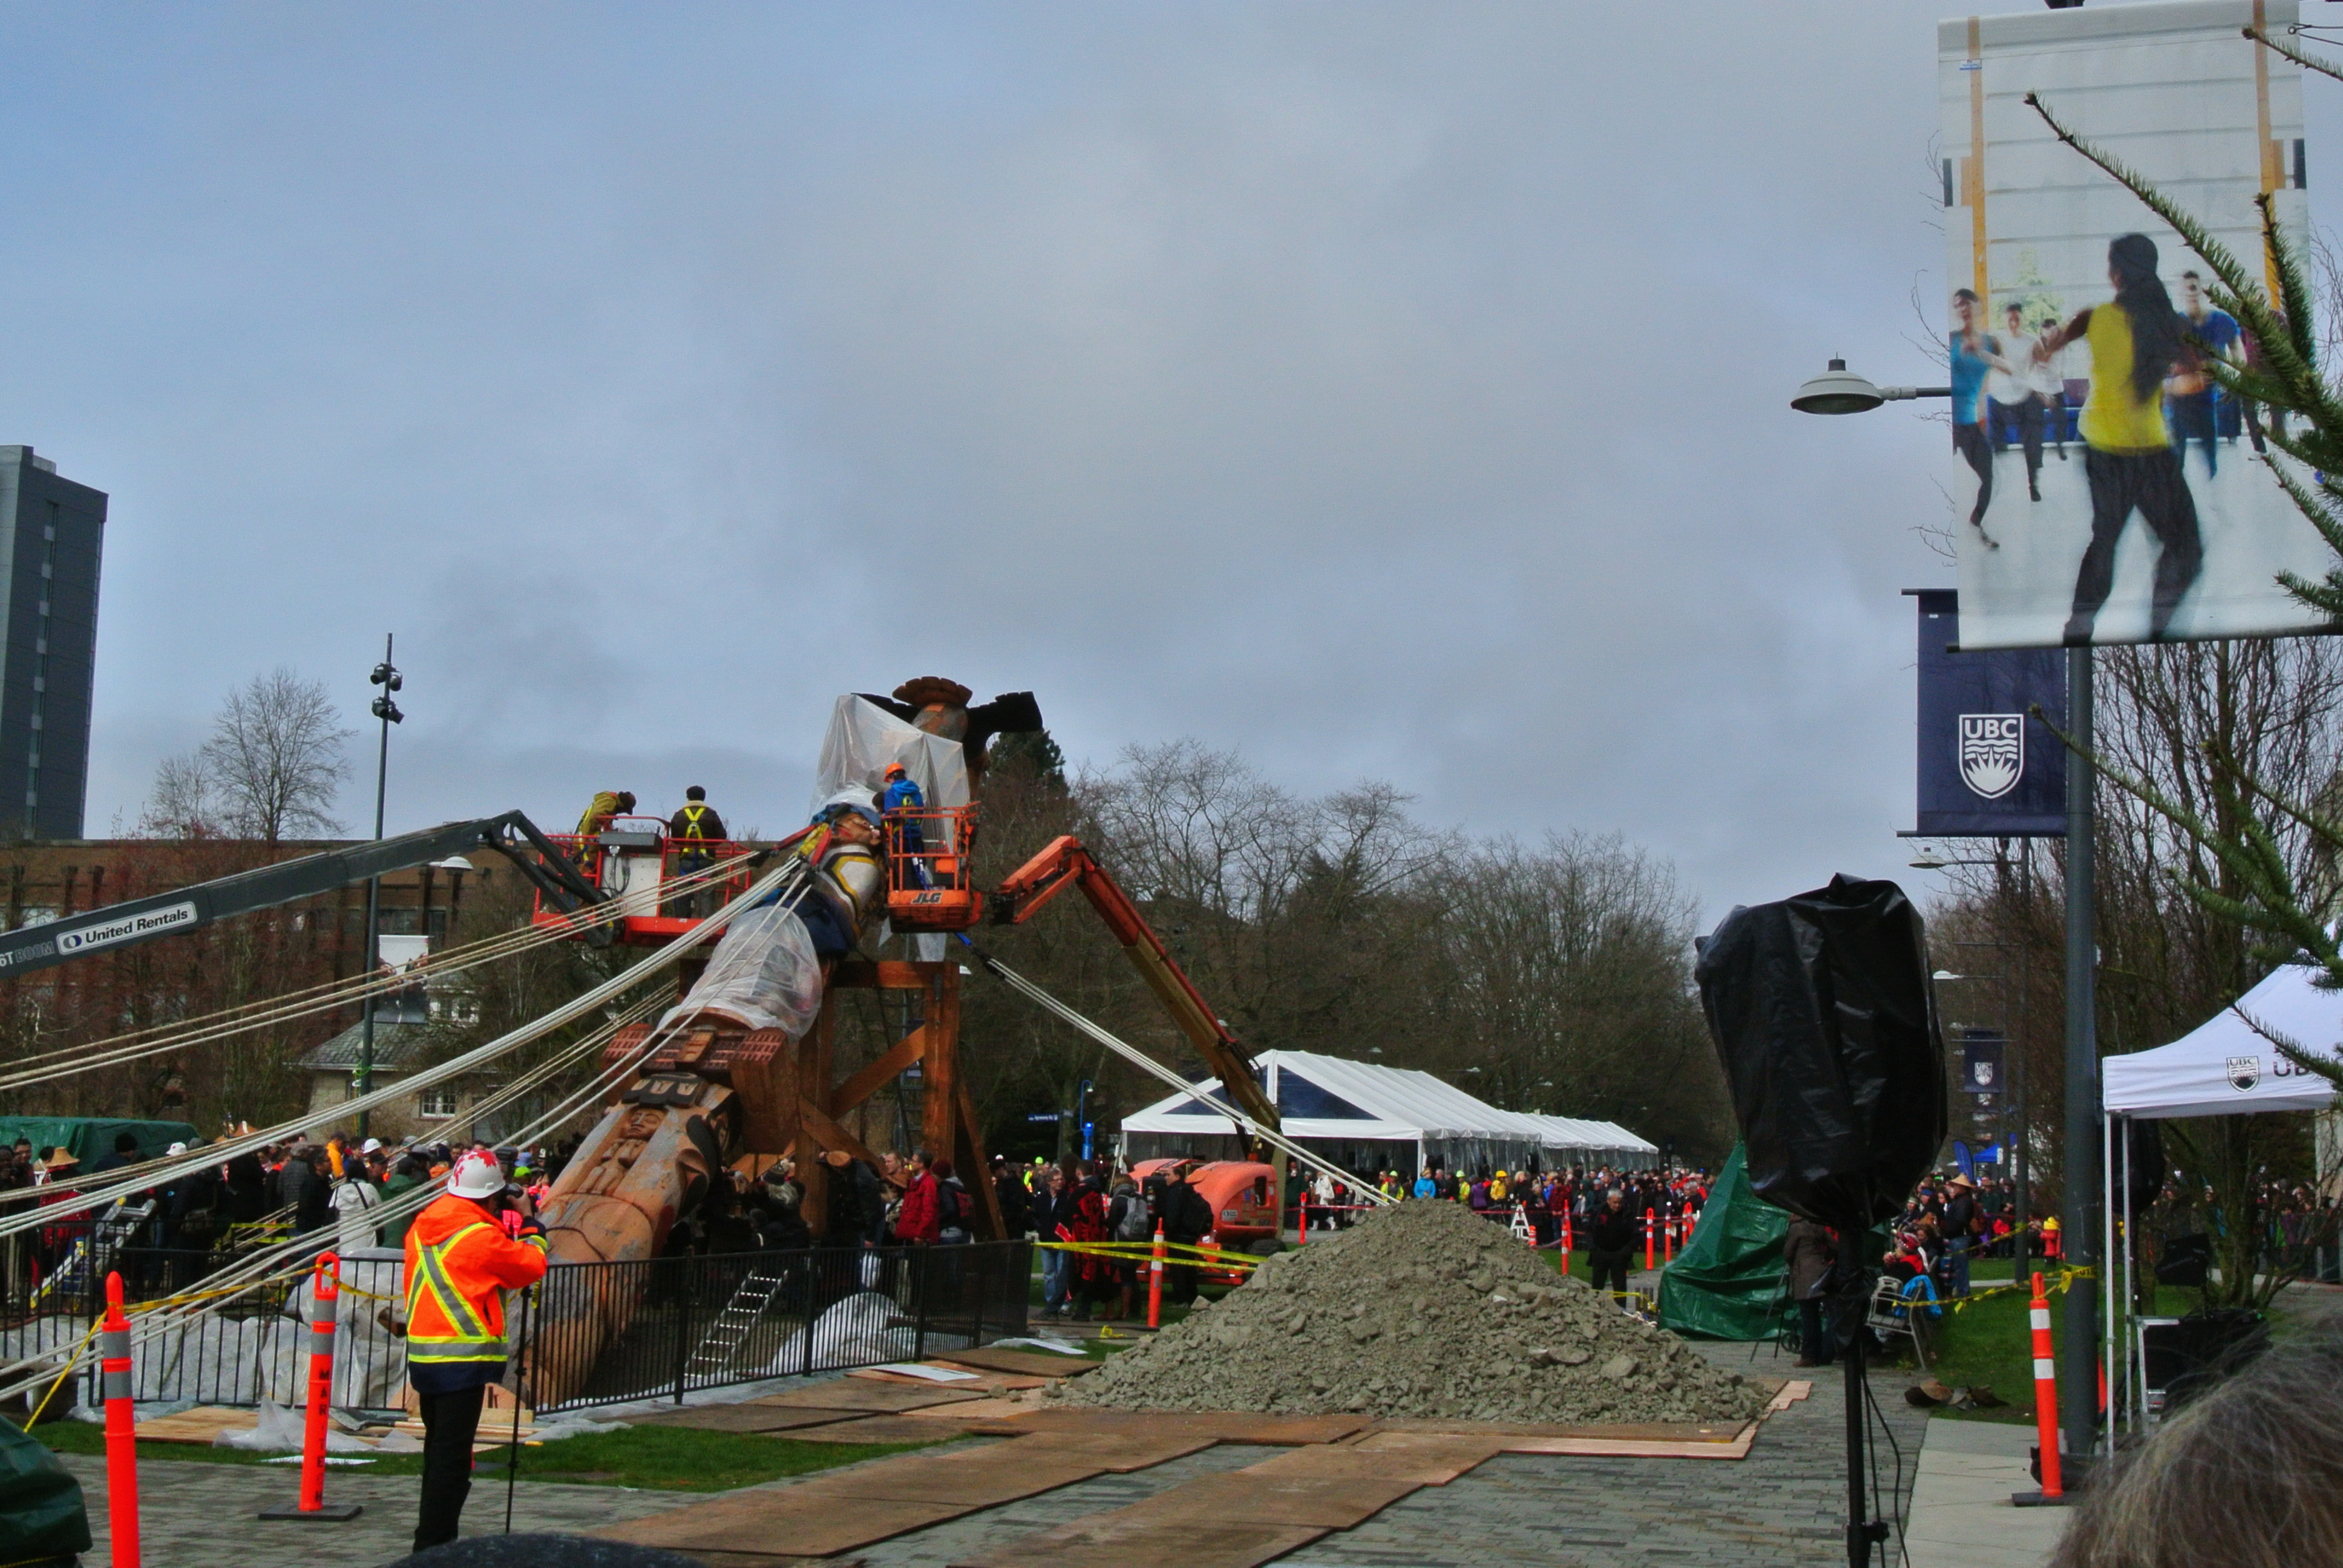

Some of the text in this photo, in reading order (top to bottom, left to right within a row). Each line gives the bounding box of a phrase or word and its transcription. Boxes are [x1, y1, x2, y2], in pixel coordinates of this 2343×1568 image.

[1964, 718, 2018, 739] UBC
[911, 892, 943, 904] JLG
[85, 909, 188, 944] United Rentals
[15, 941, 55, 963] BOOM
